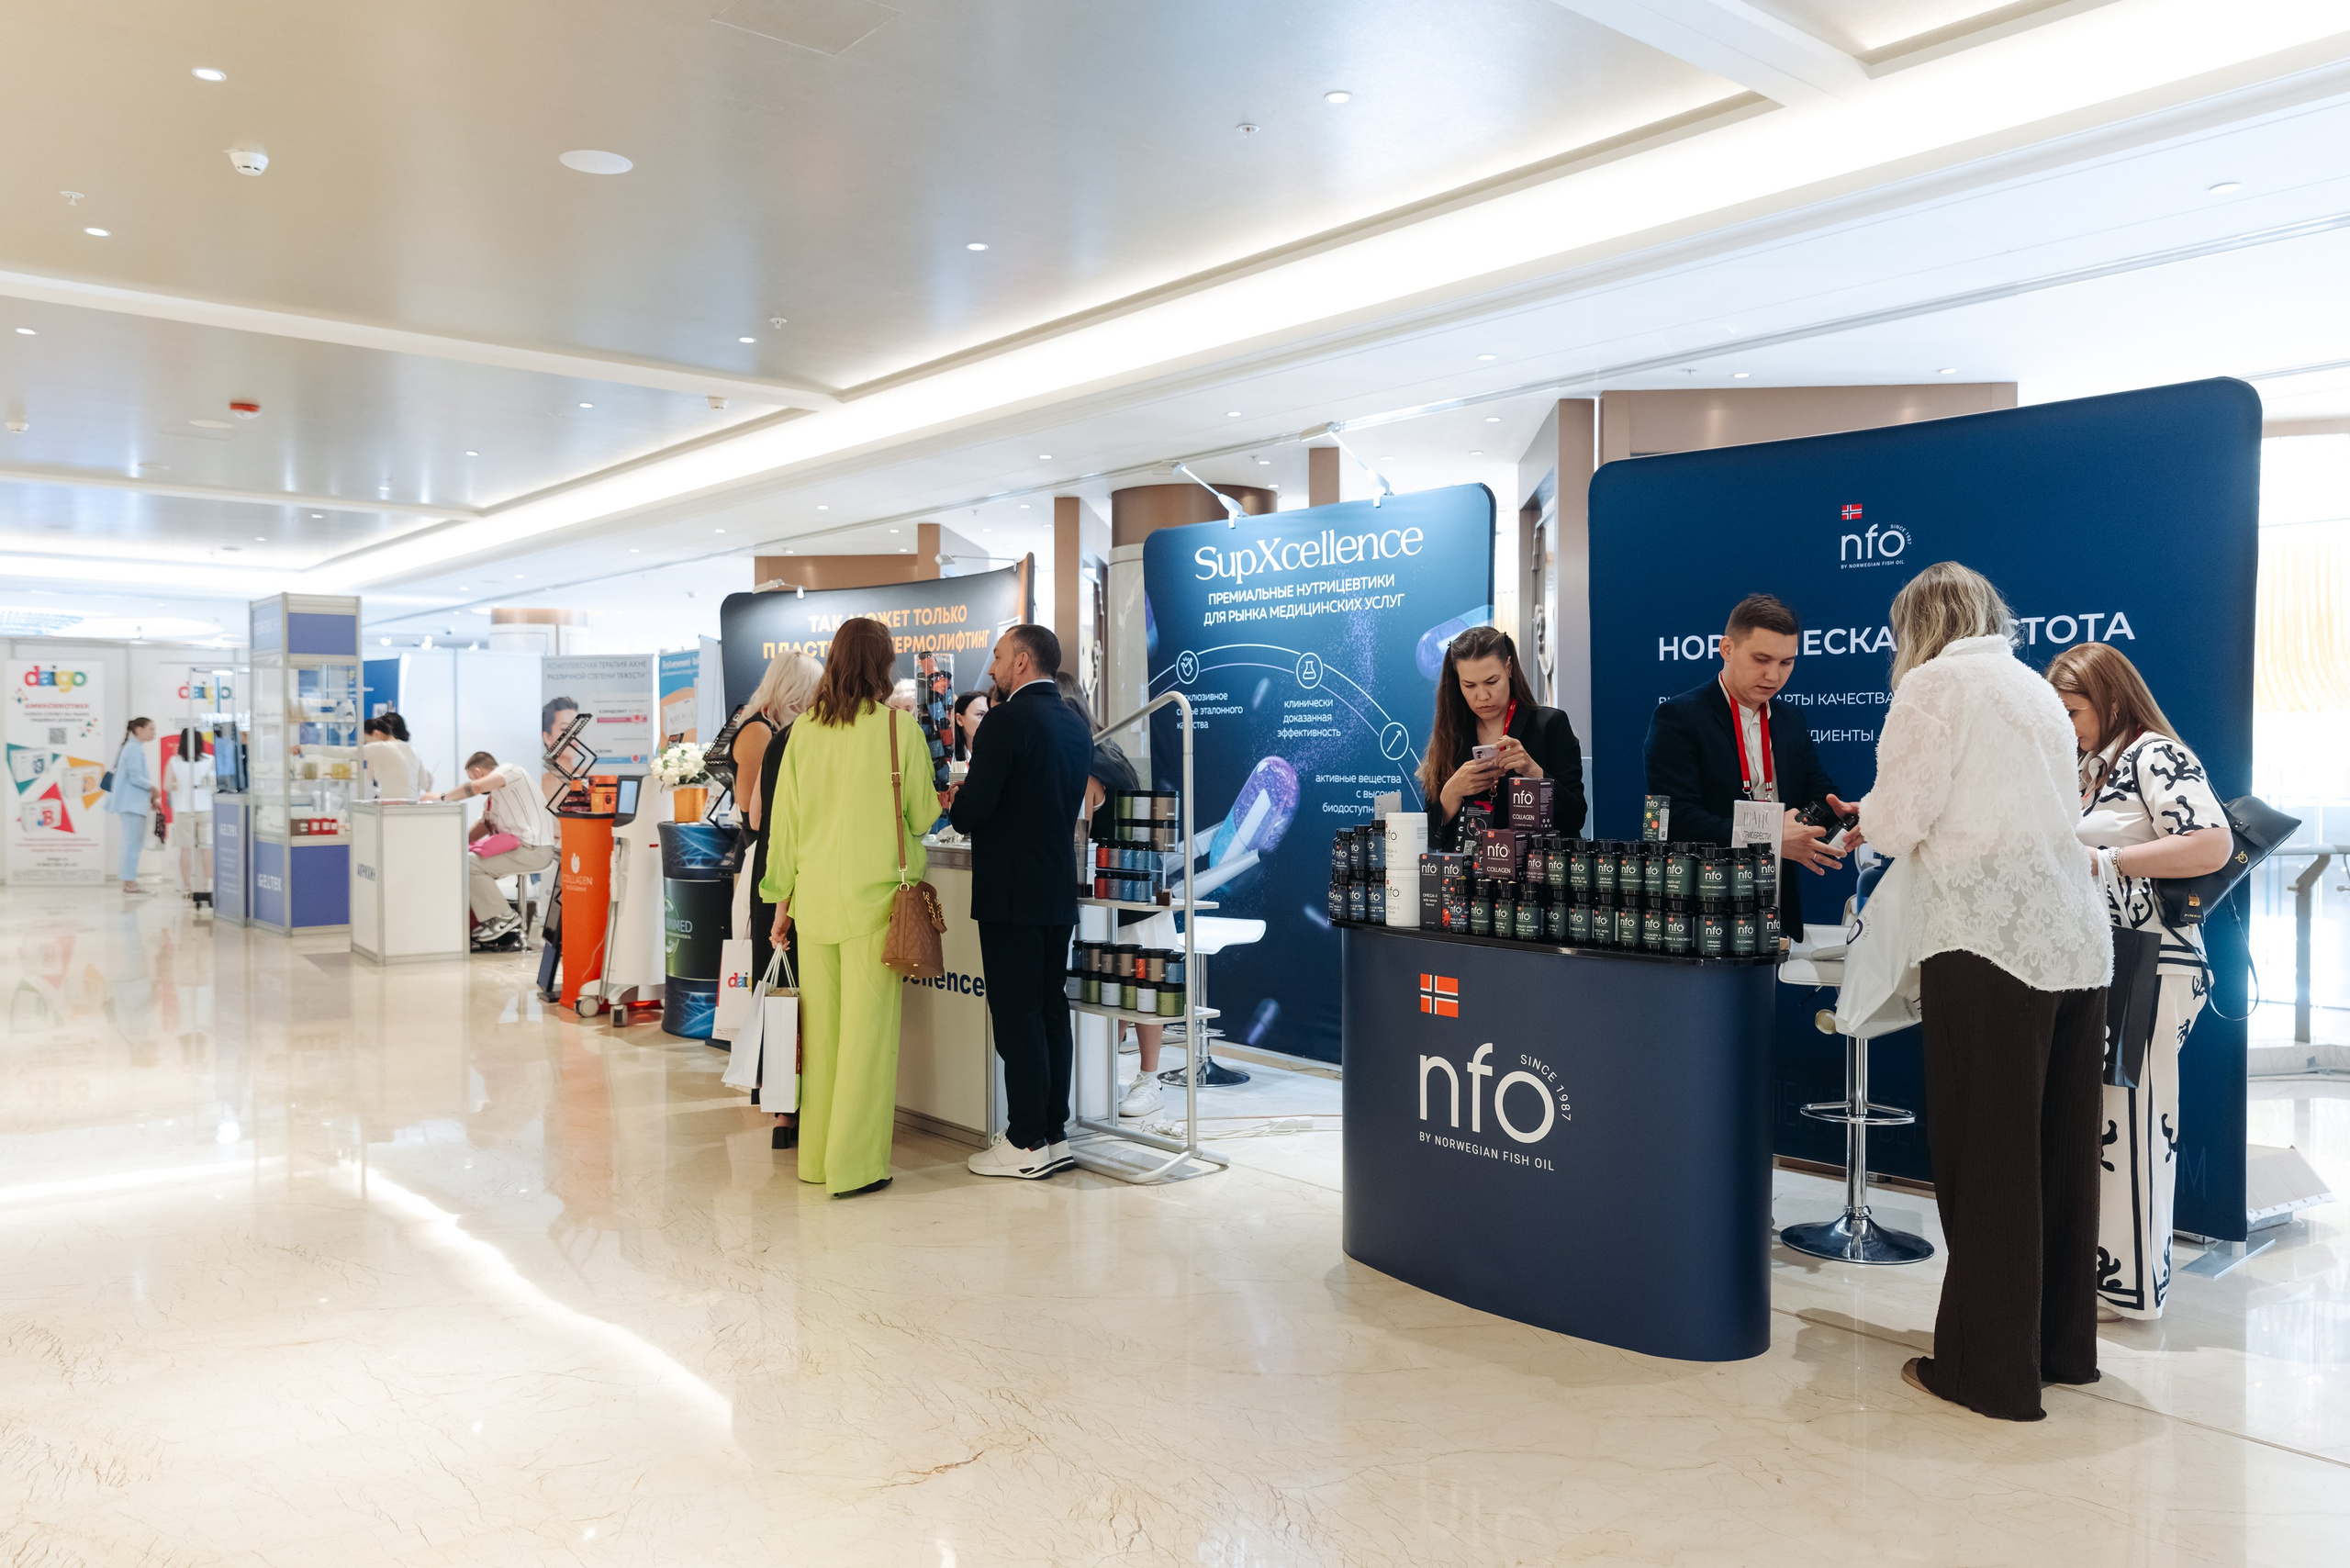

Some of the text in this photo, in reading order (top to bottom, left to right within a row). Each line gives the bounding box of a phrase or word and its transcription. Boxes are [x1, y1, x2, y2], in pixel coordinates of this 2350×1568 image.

[1890, 523, 1907, 533] SINCE
[1841, 523, 1906, 562] nfo
[1194, 526, 1424, 585] SupXcellence
[1849, 561, 1881, 569] NORWEGIAN
[1208, 574, 1395, 606] ПРЕМИАЛЬНЫЕ НУТРИЦЕВТИКИ
[1203, 593, 1405, 626] ДЛЯ РЫНКА МЕДИЦИНСКИХ УСЛУГ
[808, 614, 844, 633] ТАК
[912, 604, 968, 626] ТОЛЬКО
[547, 662, 597, 670] КОМПЛЕКСНАЯ
[629, 660, 647, 668] АКНЕ
[24, 665, 88, 693] daigo
[547, 672, 587, 680] РАЗЛИЧНОЙ
[1818, 691, 1896, 705] КАЧЕСТВА
[1283, 698, 1334, 709] клинически
[1200, 705, 1243, 716] эталонного
[1282, 713, 1332, 724] доказанная
[1277, 728, 1341, 740] эффективность
[1315, 774, 1402, 784] активные вещества
[1356, 790, 1361, 799] с
[1513, 790, 1533, 805] nfo
[1322, 801, 1374, 817] биодоступн
[1646, 800, 1659, 808] nfo
[1487, 842, 1509, 858] nfo
[1421, 862, 1438, 874] nfo
[1528, 858, 1542, 868] nfo
[1548, 860, 1563, 870] nfo
[1571, 863, 1584, 872] nfo
[1598, 863, 1614, 873] nfo
[1444, 864, 1460, 875] nfo
[1486, 866, 1511, 874] COLLAGEN
[1621, 864, 1636, 874] nfo
[1645, 866, 1659, 875] nfo
[1667, 864, 1683, 875] nfo
[1738, 869, 1753, 879] nfo
[1761, 864, 1775, 874] nfo
[563, 873, 593, 886] COLLAGEN
[1705, 870, 1722, 880] nfo
[1450, 905, 1462, 913] nfo
[1471, 906, 1483, 915] nfo
[1494, 909, 1507, 918] nfo
[1517, 912, 1530, 921] nfo
[1547, 912, 1560, 920] nfo
[1571, 913, 1583, 923] nfo
[1595, 915, 1607, 925] nfo
[1619, 917, 1635, 927] nfo
[1645, 919, 1660, 929] nfo
[1668, 922, 1684, 932] nfo
[1706, 925, 1723, 935] nfo
[1738, 924, 1754, 935] nfo
[1419, 1042, 1555, 1144] nfo
[1520, 1054, 1572, 1122] SINCE 1987
[1419, 1131, 1555, 1171] BY NORWEGIAN FISH OIL
